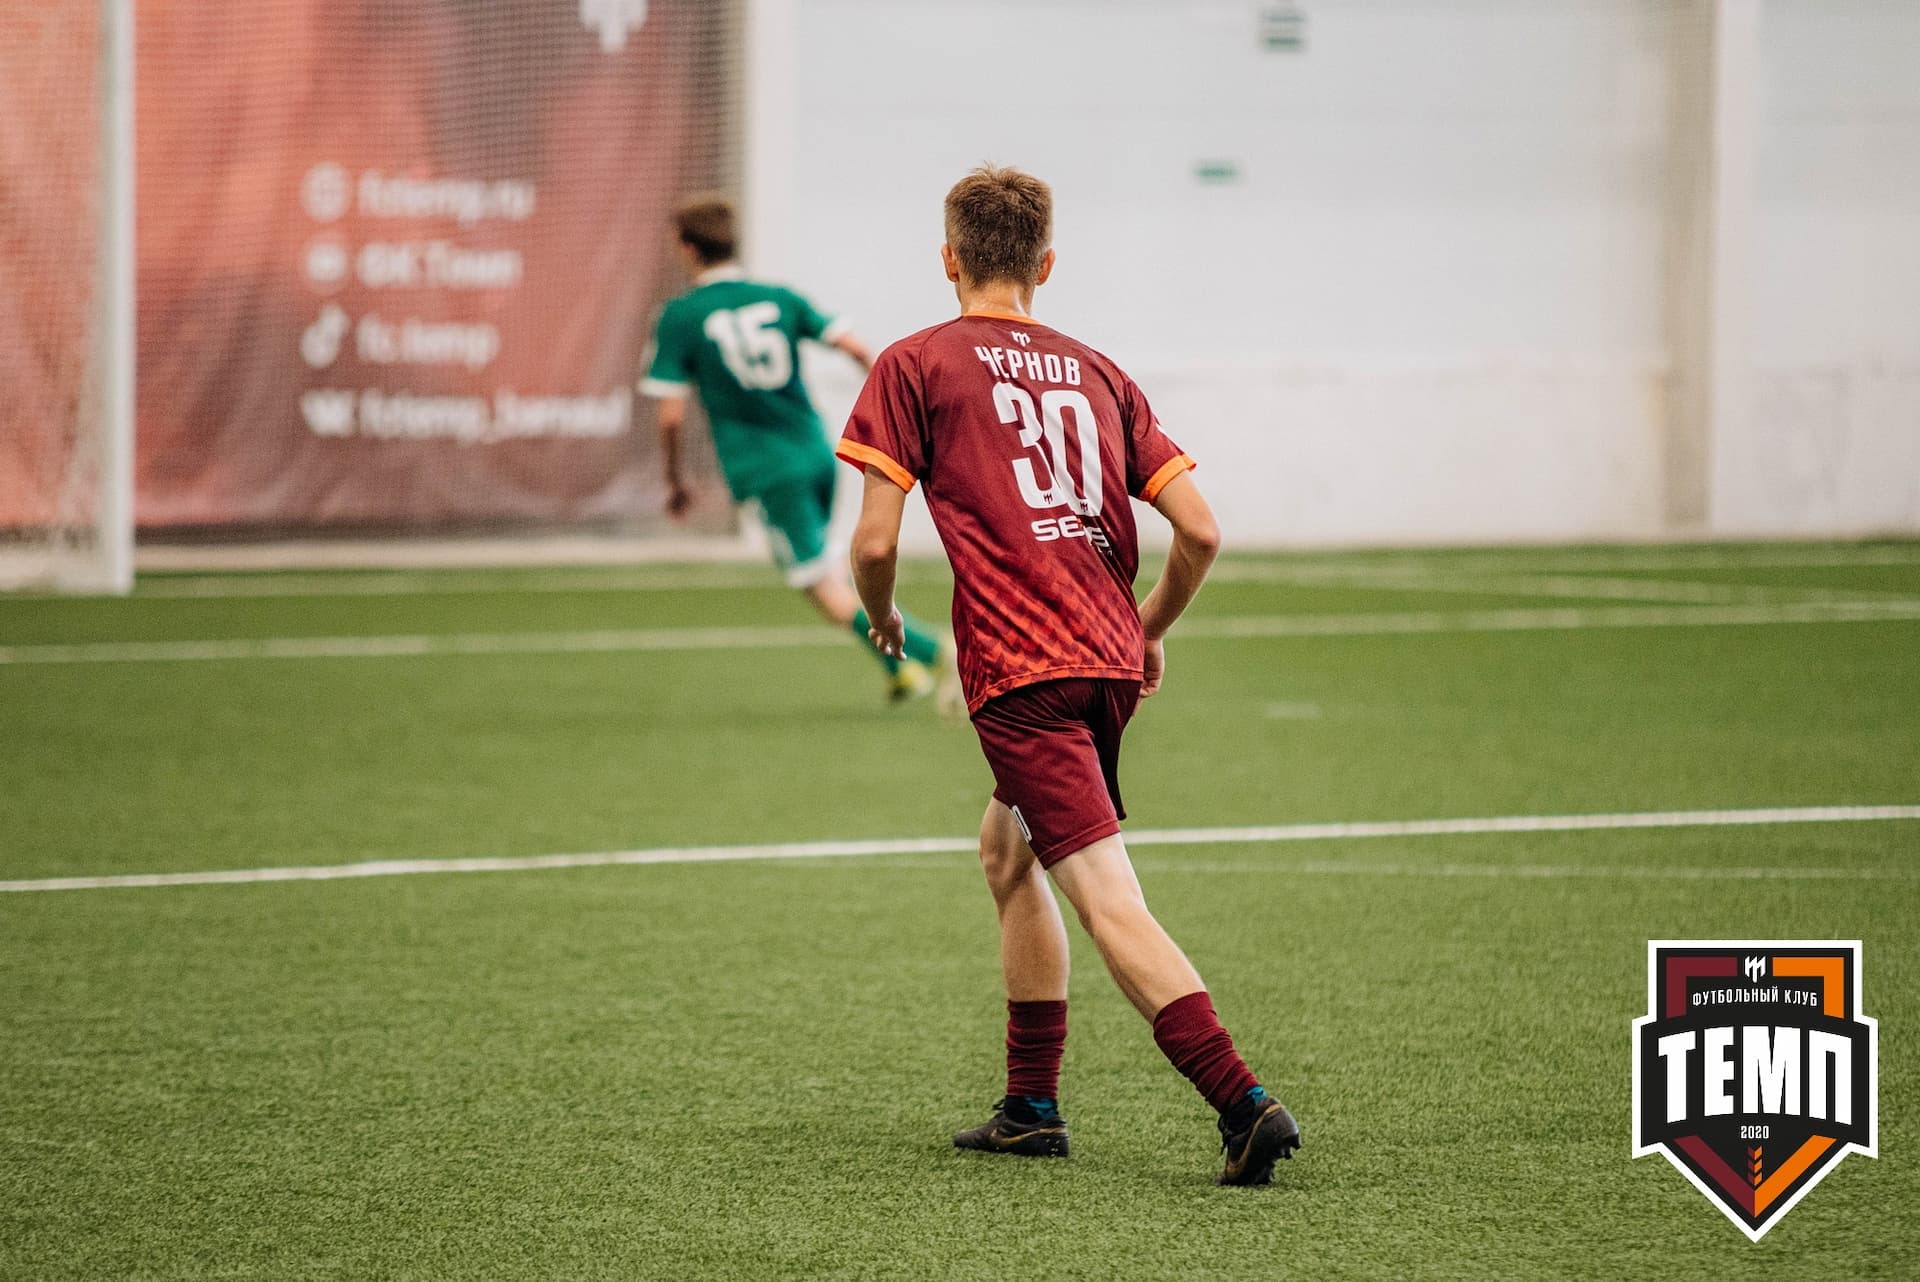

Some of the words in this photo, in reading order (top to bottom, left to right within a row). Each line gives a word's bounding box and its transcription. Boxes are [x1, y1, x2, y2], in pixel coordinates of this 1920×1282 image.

[703, 301, 792, 390] 15
[974, 346, 1081, 386] ЧЕРНОВ
[992, 381, 1103, 517] 30
